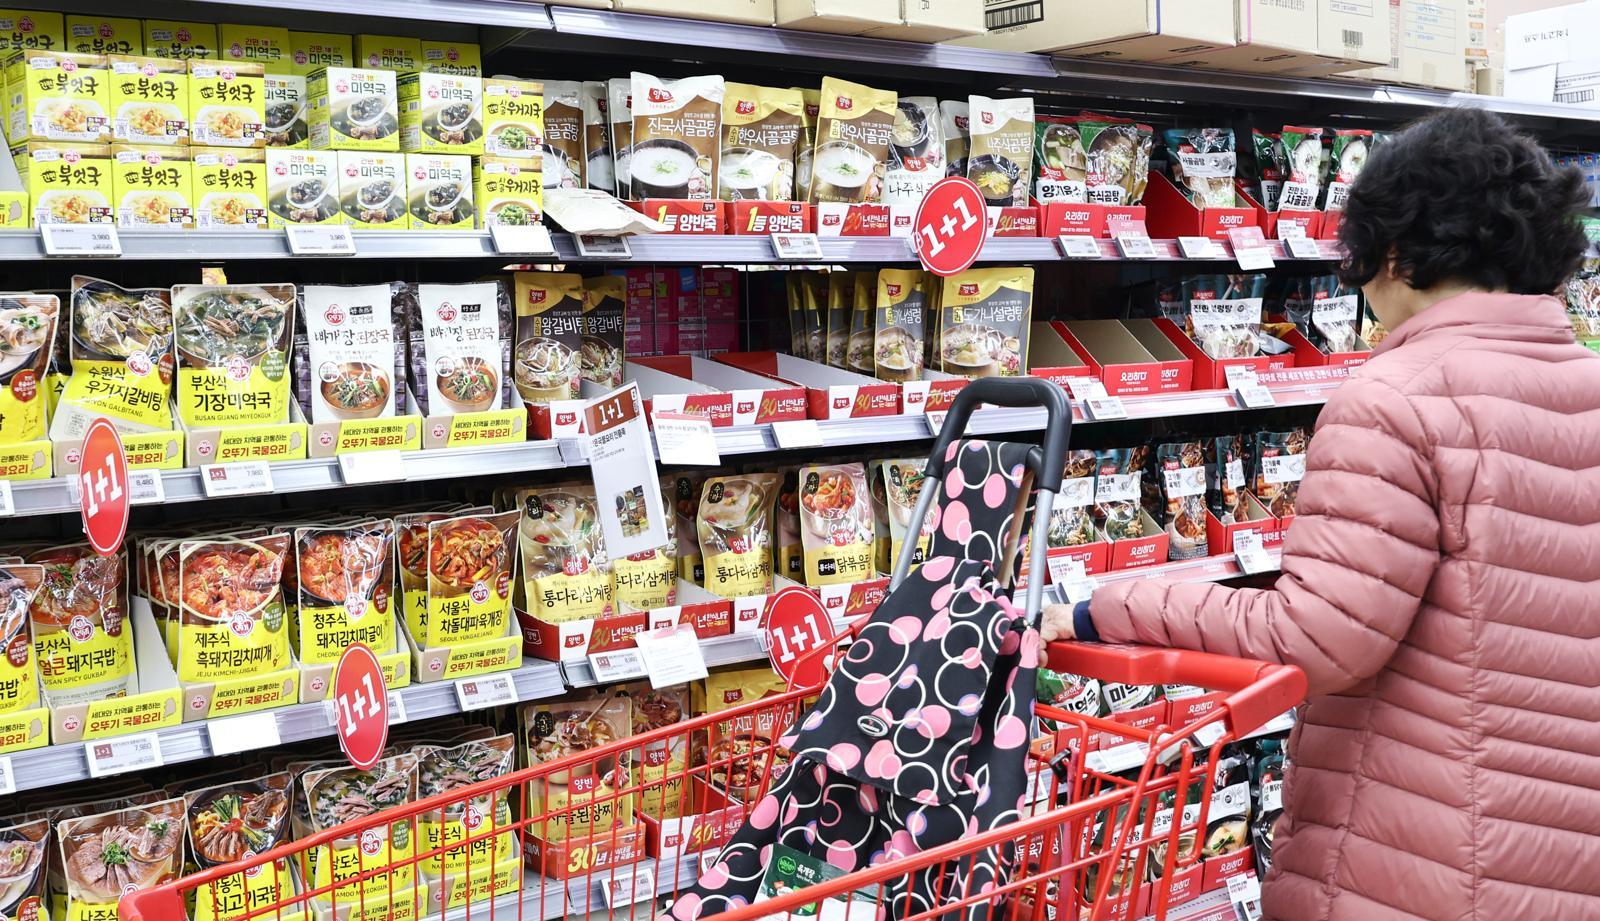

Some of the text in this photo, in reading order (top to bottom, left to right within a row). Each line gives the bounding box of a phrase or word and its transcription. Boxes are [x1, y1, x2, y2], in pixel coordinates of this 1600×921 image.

[245, 46, 281, 59] 미역국
[309, 53, 343, 66] 미역국
[382, 56, 414, 69] 미역국
[57, 73, 99, 96] 북엇국
[138, 78, 179, 100] 북엇국
[351, 82, 386, 95] 미역국
[215, 82, 255, 103] 북엇국
[441, 88, 473, 101] 미역국
[653, 89, 671, 100] 양반
[507, 100, 541, 118] 우거지국
[740, 102, 753, 113] 양반
[839, 97, 850, 109] 양반
[648, 117, 716, 138] 진국사골곰탕
[987, 136, 1031, 153] 나주식곰탕
[908, 159, 921, 167] 양반
[59, 165, 102, 186] 북엇국
[142, 166, 182, 188] 북엇국
[291, 164, 327, 177] 미역국
[361, 165, 395, 178] 미역국
[429, 167, 462, 181] 미역국
[218, 169, 257, 189] 북엇국
[506, 178, 540, 195] 우거지국
[680, 215, 716, 232] 양반죽
[747, 207, 802, 232] 1등 양반죽
[923, 197, 977, 257] 1+1
[963, 285, 976, 294] 양반
[531, 292, 543, 301] 양반
[963, 306, 1022, 322] 도가니설렁탕
[541, 317, 583, 335] 왕갈비탕
[587, 316, 623, 333] 왕갈비탕
[466, 327, 495, 340] 된장국
[88, 367, 126, 381] 수원식
[1120, 372, 1147, 382] 요리하다
[191, 375, 227, 390] 부산식
[85, 381, 162, 411] 우거지갈비탕
[194, 393, 271, 411] 기장미역국
[740, 402, 752, 411] 양반
[836, 399, 847, 407] 양반
[108, 404, 143, 417] GALBITANG
[598, 399, 624, 426] 1+1
[559, 414, 572, 423] 양반
[380, 425, 403, 433] 관통하는
[453, 429, 510, 440] 오뚜기 국물요리
[264, 434, 287, 442] 관통하는
[342, 436, 403, 448] 오뚜기 국물요리
[222, 445, 287, 457] 오뚜기 국물요리
[82, 453, 122, 518] 1+1
[836, 534, 849, 543] 양반
[733, 541, 748, 551] 양반
[1130, 544, 1155, 555] 요리하다
[566, 562, 582, 572] 양반
[716, 564, 770, 583] 통다리삼계탕
[543, 584, 612, 607] 통다리삼계탕
[830, 598, 841, 606] 양반
[439, 599, 470, 613] 서울식
[743, 611, 755, 619] 양반
[313, 614, 348, 630] 청주식
[440, 610, 503, 634] 차돌대파육개장
[195, 631, 230, 648] 제주식
[316, 626, 383, 649] 돼지김치짜글이
[460, 631, 493, 641] YUKGAEJANG
[568, 636, 582, 645] 양반
[772, 614, 826, 664] 1+1
[35, 638, 71, 654] 부산식
[196, 646, 272, 668] 흑돼지김치찌개
[469, 651, 484, 659] 지역을
[485, 648, 506, 656] 관통하는
[450, 657, 505, 672] 오뚜기 국물요리
[83, 671, 107, 681] GUKBAP
[213, 666, 258, 677] KIMCHI-JJIGAE
[237, 686, 255, 695] 지역을
[256, 683, 280, 691] 관통하는
[215, 692, 279, 710] 오뚜기 국물요리
[727, 692, 738, 700] 양반
[113, 707, 134, 716] 지역을
[135, 703, 161, 712] 관통하는
[339, 672, 381, 738] 1+1
[1188, 701, 1212, 713] 요리하다
[90, 712, 161, 732] 오뚜기 국물요리
[649, 751, 665, 763] 양반
[574, 778, 593, 790] 양반
[797, 864, 815, 878] 육개장
[1220, 858, 1243, 871] 요리하다
